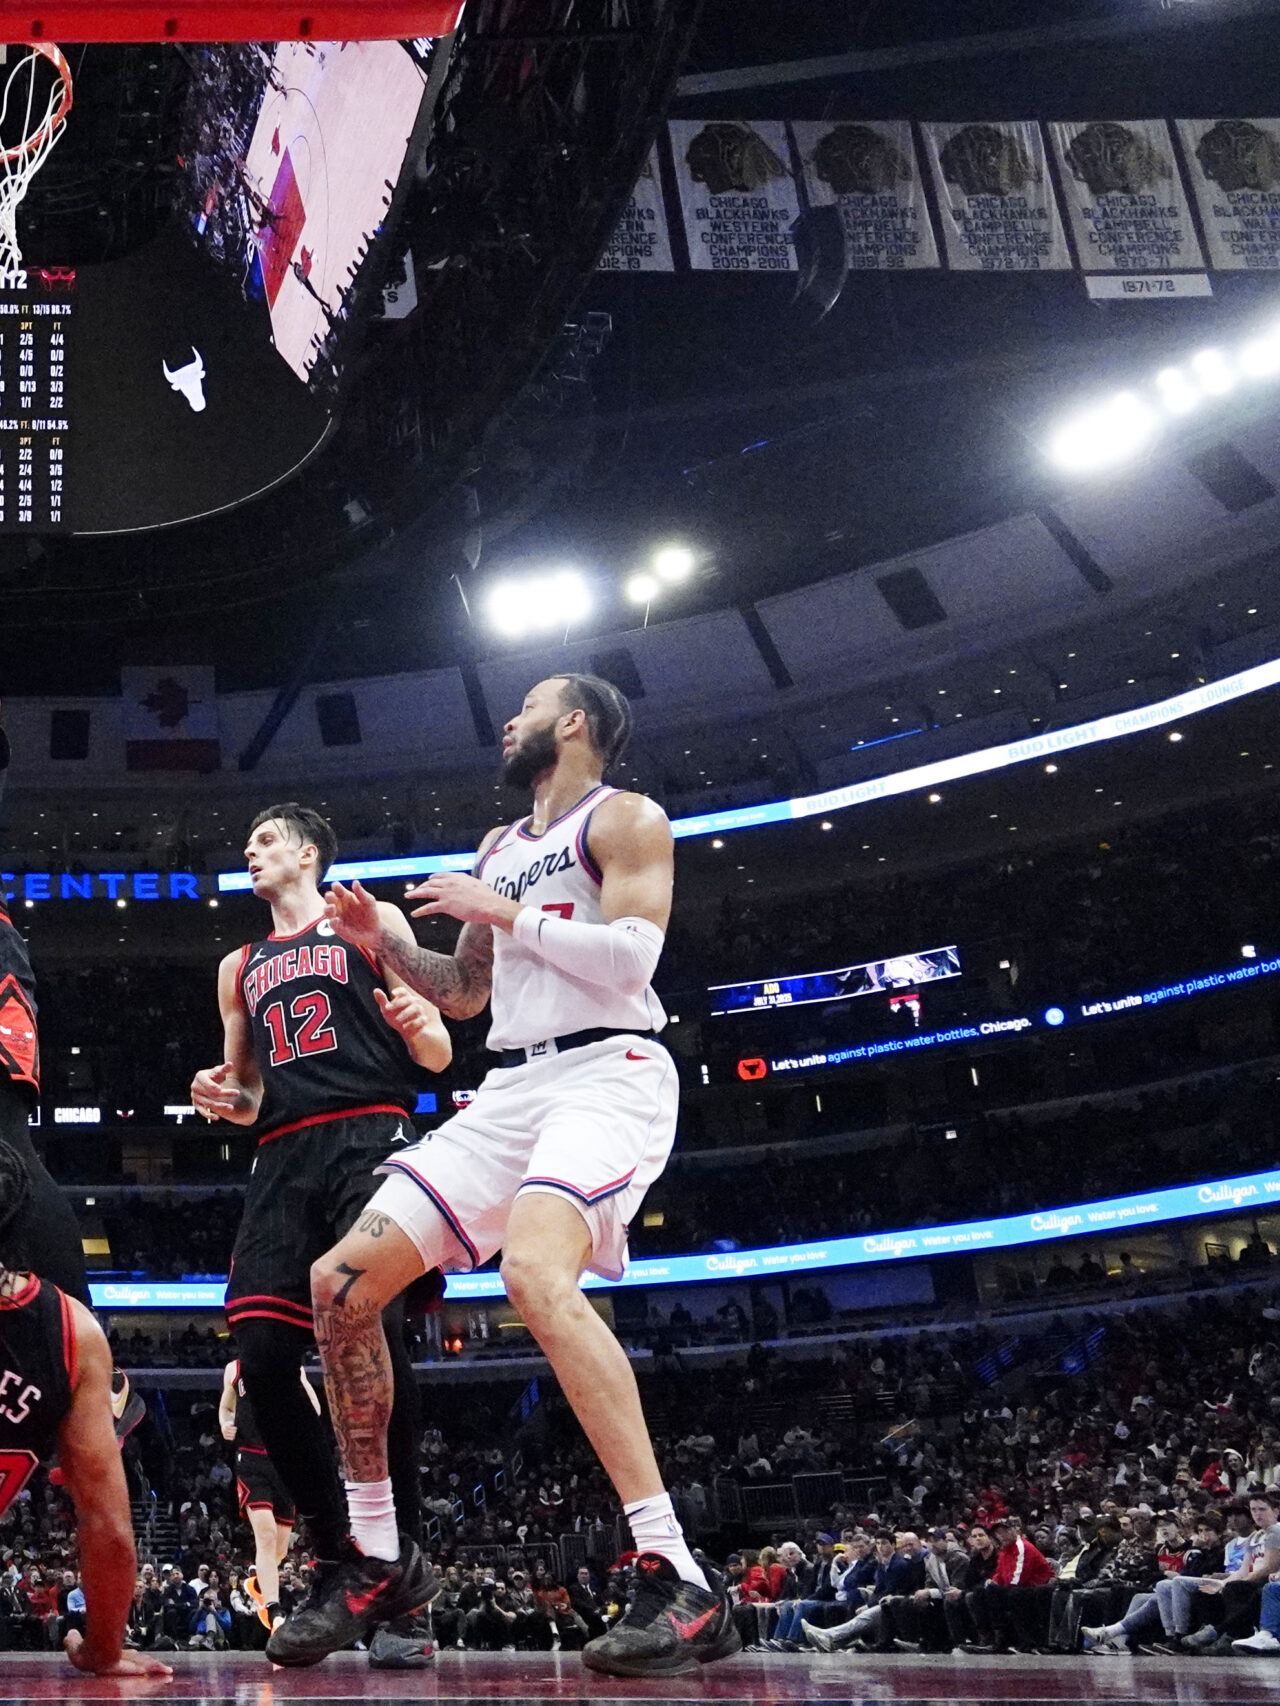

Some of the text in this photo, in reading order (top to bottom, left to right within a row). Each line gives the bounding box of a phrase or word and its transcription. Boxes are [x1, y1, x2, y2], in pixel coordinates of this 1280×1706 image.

[710, 197, 768, 210] CHICAGO
[696, 208, 790, 221] BLACKHAWKS
[1083, 207, 1178, 219] BLACKHAWKS
[711, 221, 780, 233] WESTERN
[1093, 219, 1170, 231] CAMPBELL
[701, 232, 792, 245] CONFERENCE
[1088, 230, 1184, 243] CONFERENCE
[709, 244, 789, 257] CHAMPIONS
[712, 257, 790, 270] 2009-2010
[54, 322, 61, 330] FT
[20, 333, 33, 345] 2/5
[50, 333, 64, 345] 4/4
[20, 349, 34, 361] 4/5
[50, 380, 64, 392] 3/3
[21, 396, 32, 408] 1/1
[50, 396, 64, 408] 2/2
[19, 448, 32, 460] 2/2
[19, 464, 32, 476] 2/4
[18, 480, 32, 492] 4/4
[19, 495, 32, 506] 2/5
[1008, 677, 1245, 760] BUD LIGHT CHAMPIONS LOUNGE
[806, 781, 886, 812] BUD LIGHT
[488, 846, 577, 902] lippers
[244, 945, 348, 1017] CHICAGO
[763, 983, 780, 994] ADO
[1082, 965, 1260, 1016] Let's unite against plastic water
[754, 994, 770, 1006] JULY
[263, 990, 338, 1066] 12
[772, 1018, 1032, 1072] Let's unite against plastic water bottles, Chicago.
[54, 1108, 100, 1122] CHICAGO
[1198, 1184, 1258, 1204] Culligan
[1030, 1208, 1136, 1234] Culligan Water you
[864, 1238, 918, 1256] Culligan
[706, 1256, 758, 1275] Culligan
[104, 1287, 152, 1304] Culligan
